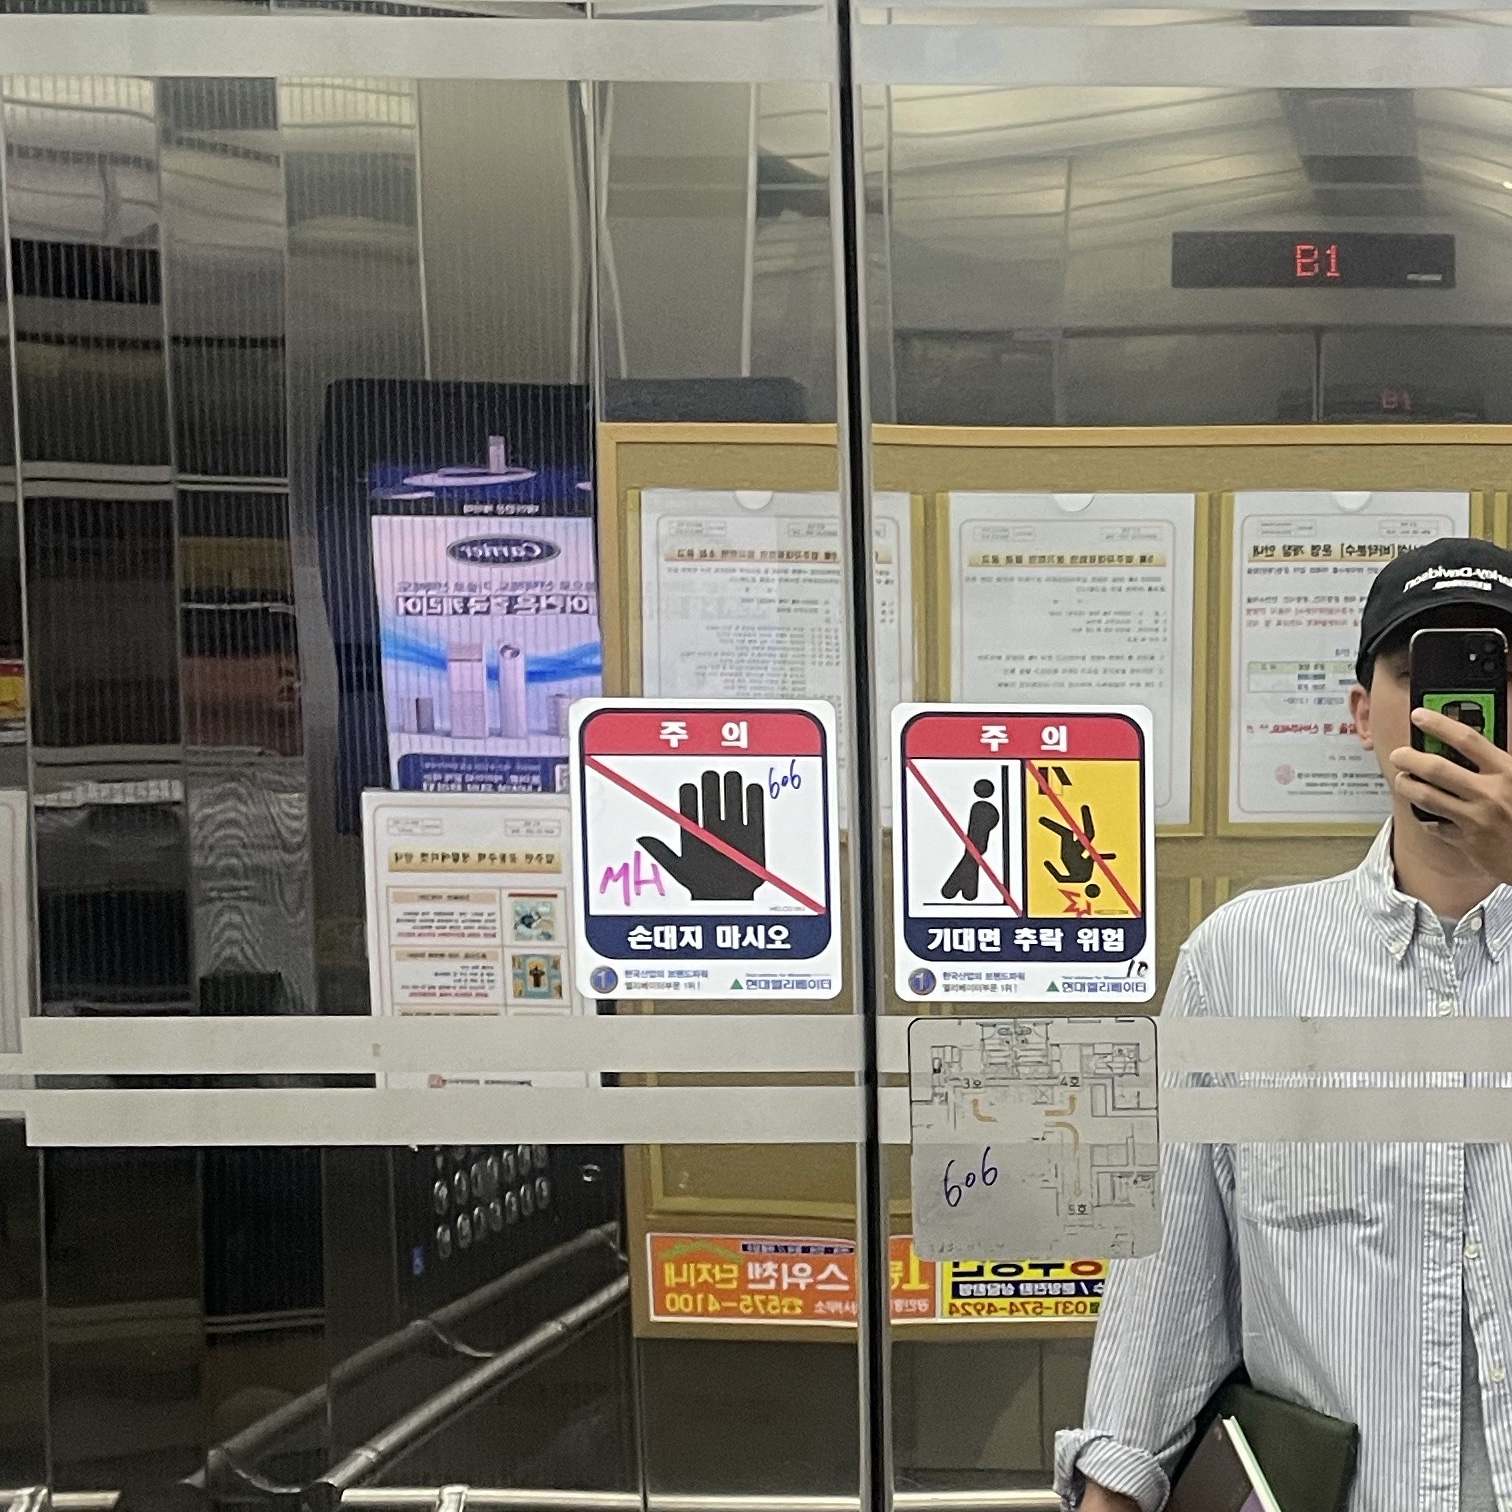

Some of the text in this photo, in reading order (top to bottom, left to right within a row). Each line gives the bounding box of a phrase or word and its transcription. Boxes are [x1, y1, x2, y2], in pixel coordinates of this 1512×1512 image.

[1295, 244, 1341, 278] B1
[768, 759, 802, 799] 606
[627, 924, 792, 950] 손대지 마시오
[927, 927, 1125, 953] 기대면 추락 위험
[944, 1146, 998, 1207] 606
